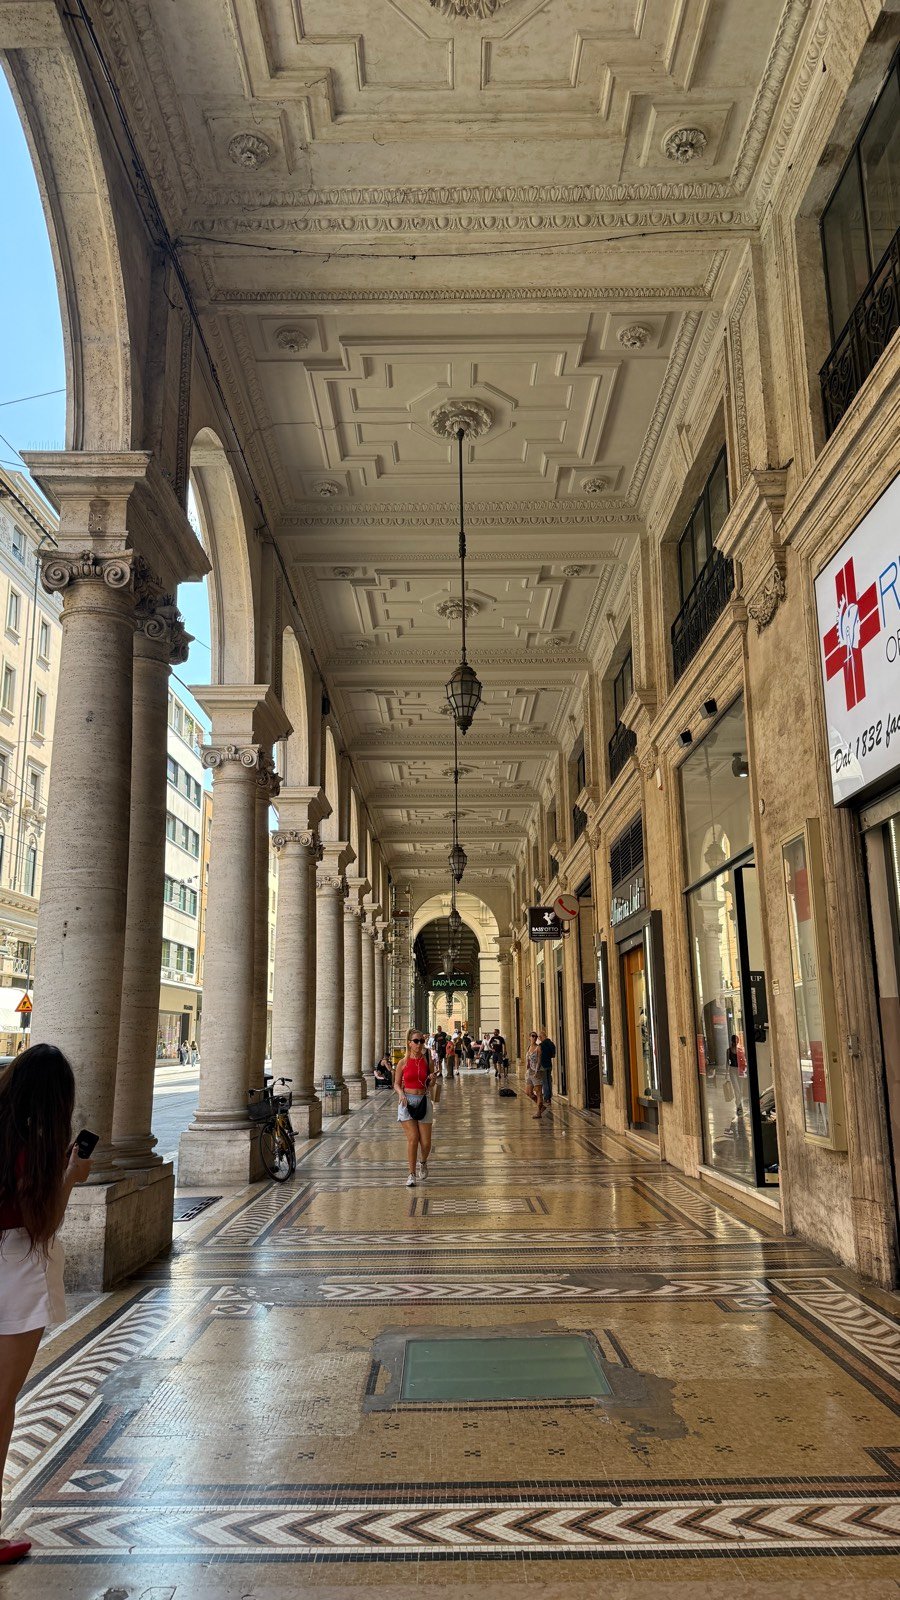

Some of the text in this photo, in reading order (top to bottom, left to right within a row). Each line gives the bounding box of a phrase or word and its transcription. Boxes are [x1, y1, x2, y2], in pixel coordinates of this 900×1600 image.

[879, 556, 900, 628] R
[834, 742, 852, 773] Dal
[856, 719, 883, 760] 1832
[432, 979, 468, 987] FARMACIA
